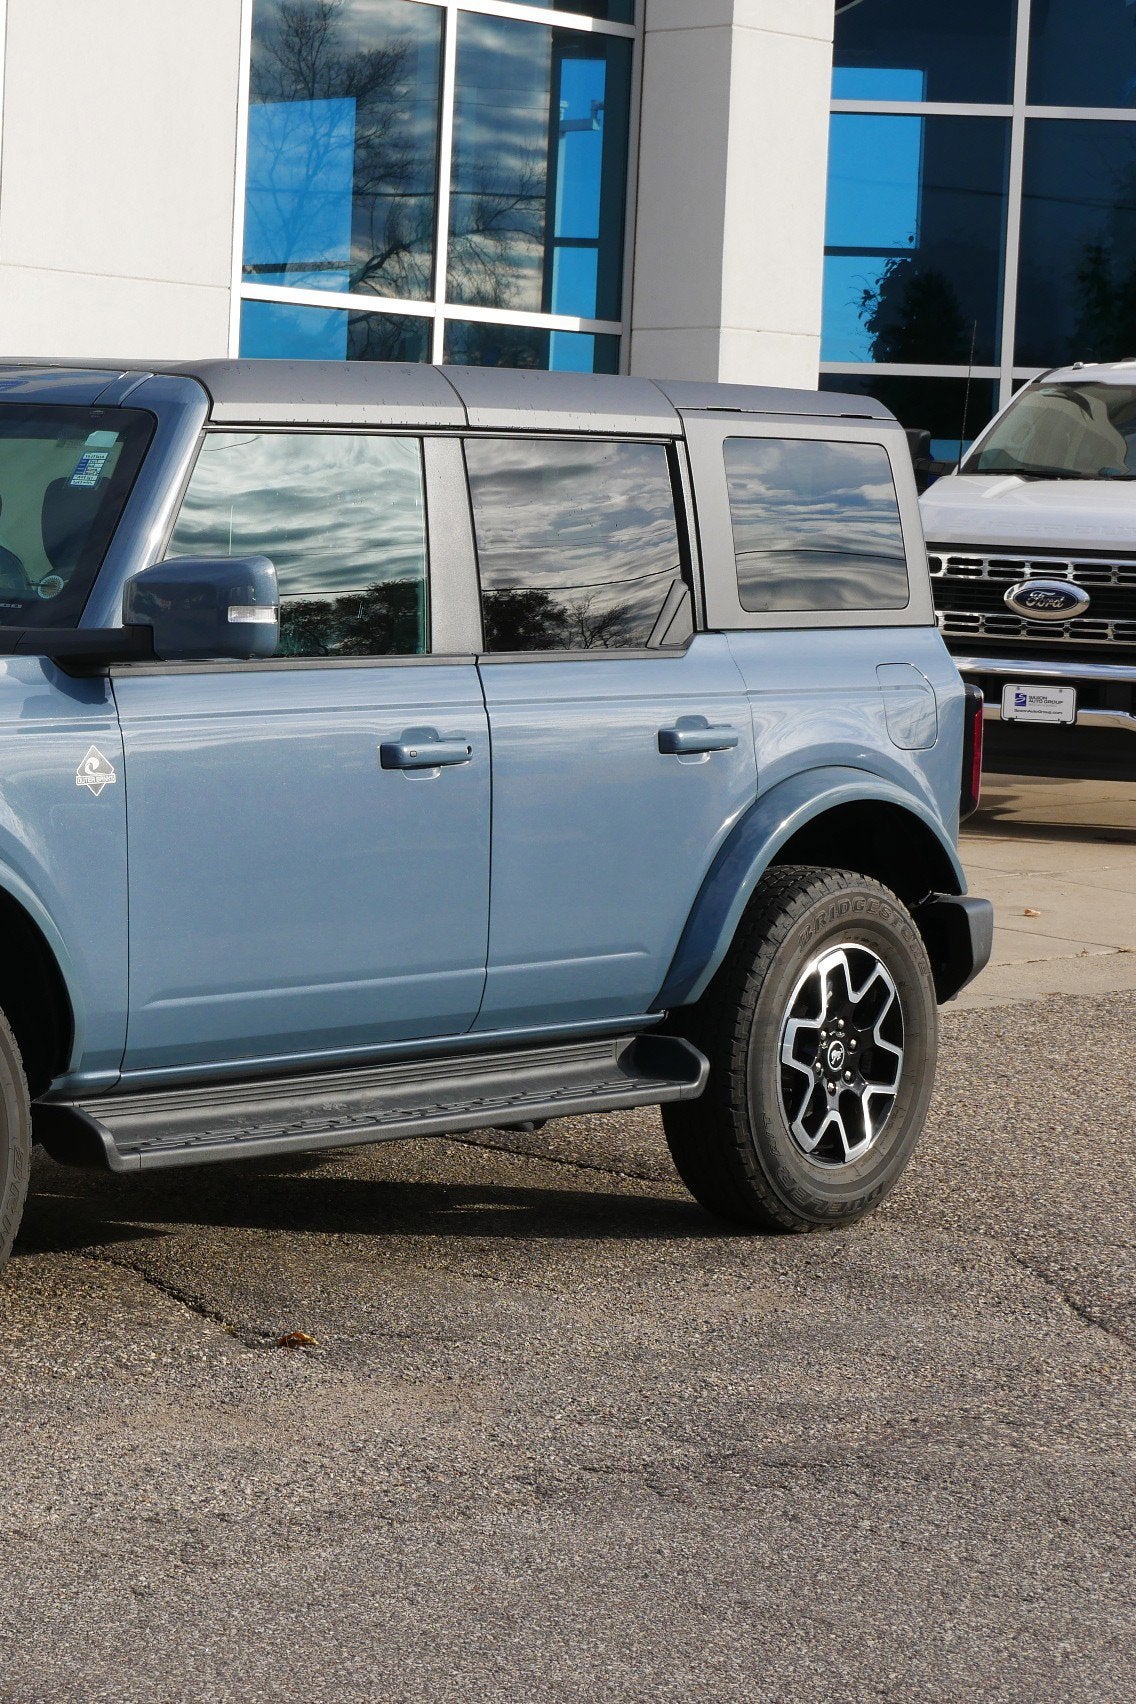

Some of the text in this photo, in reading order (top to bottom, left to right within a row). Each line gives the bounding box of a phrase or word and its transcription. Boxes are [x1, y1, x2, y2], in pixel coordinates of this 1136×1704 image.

[1025, 590, 1064, 608] Ford
[77, 776, 95, 784] OUTER
[797, 896, 931, 978] BRIDGESTONE
